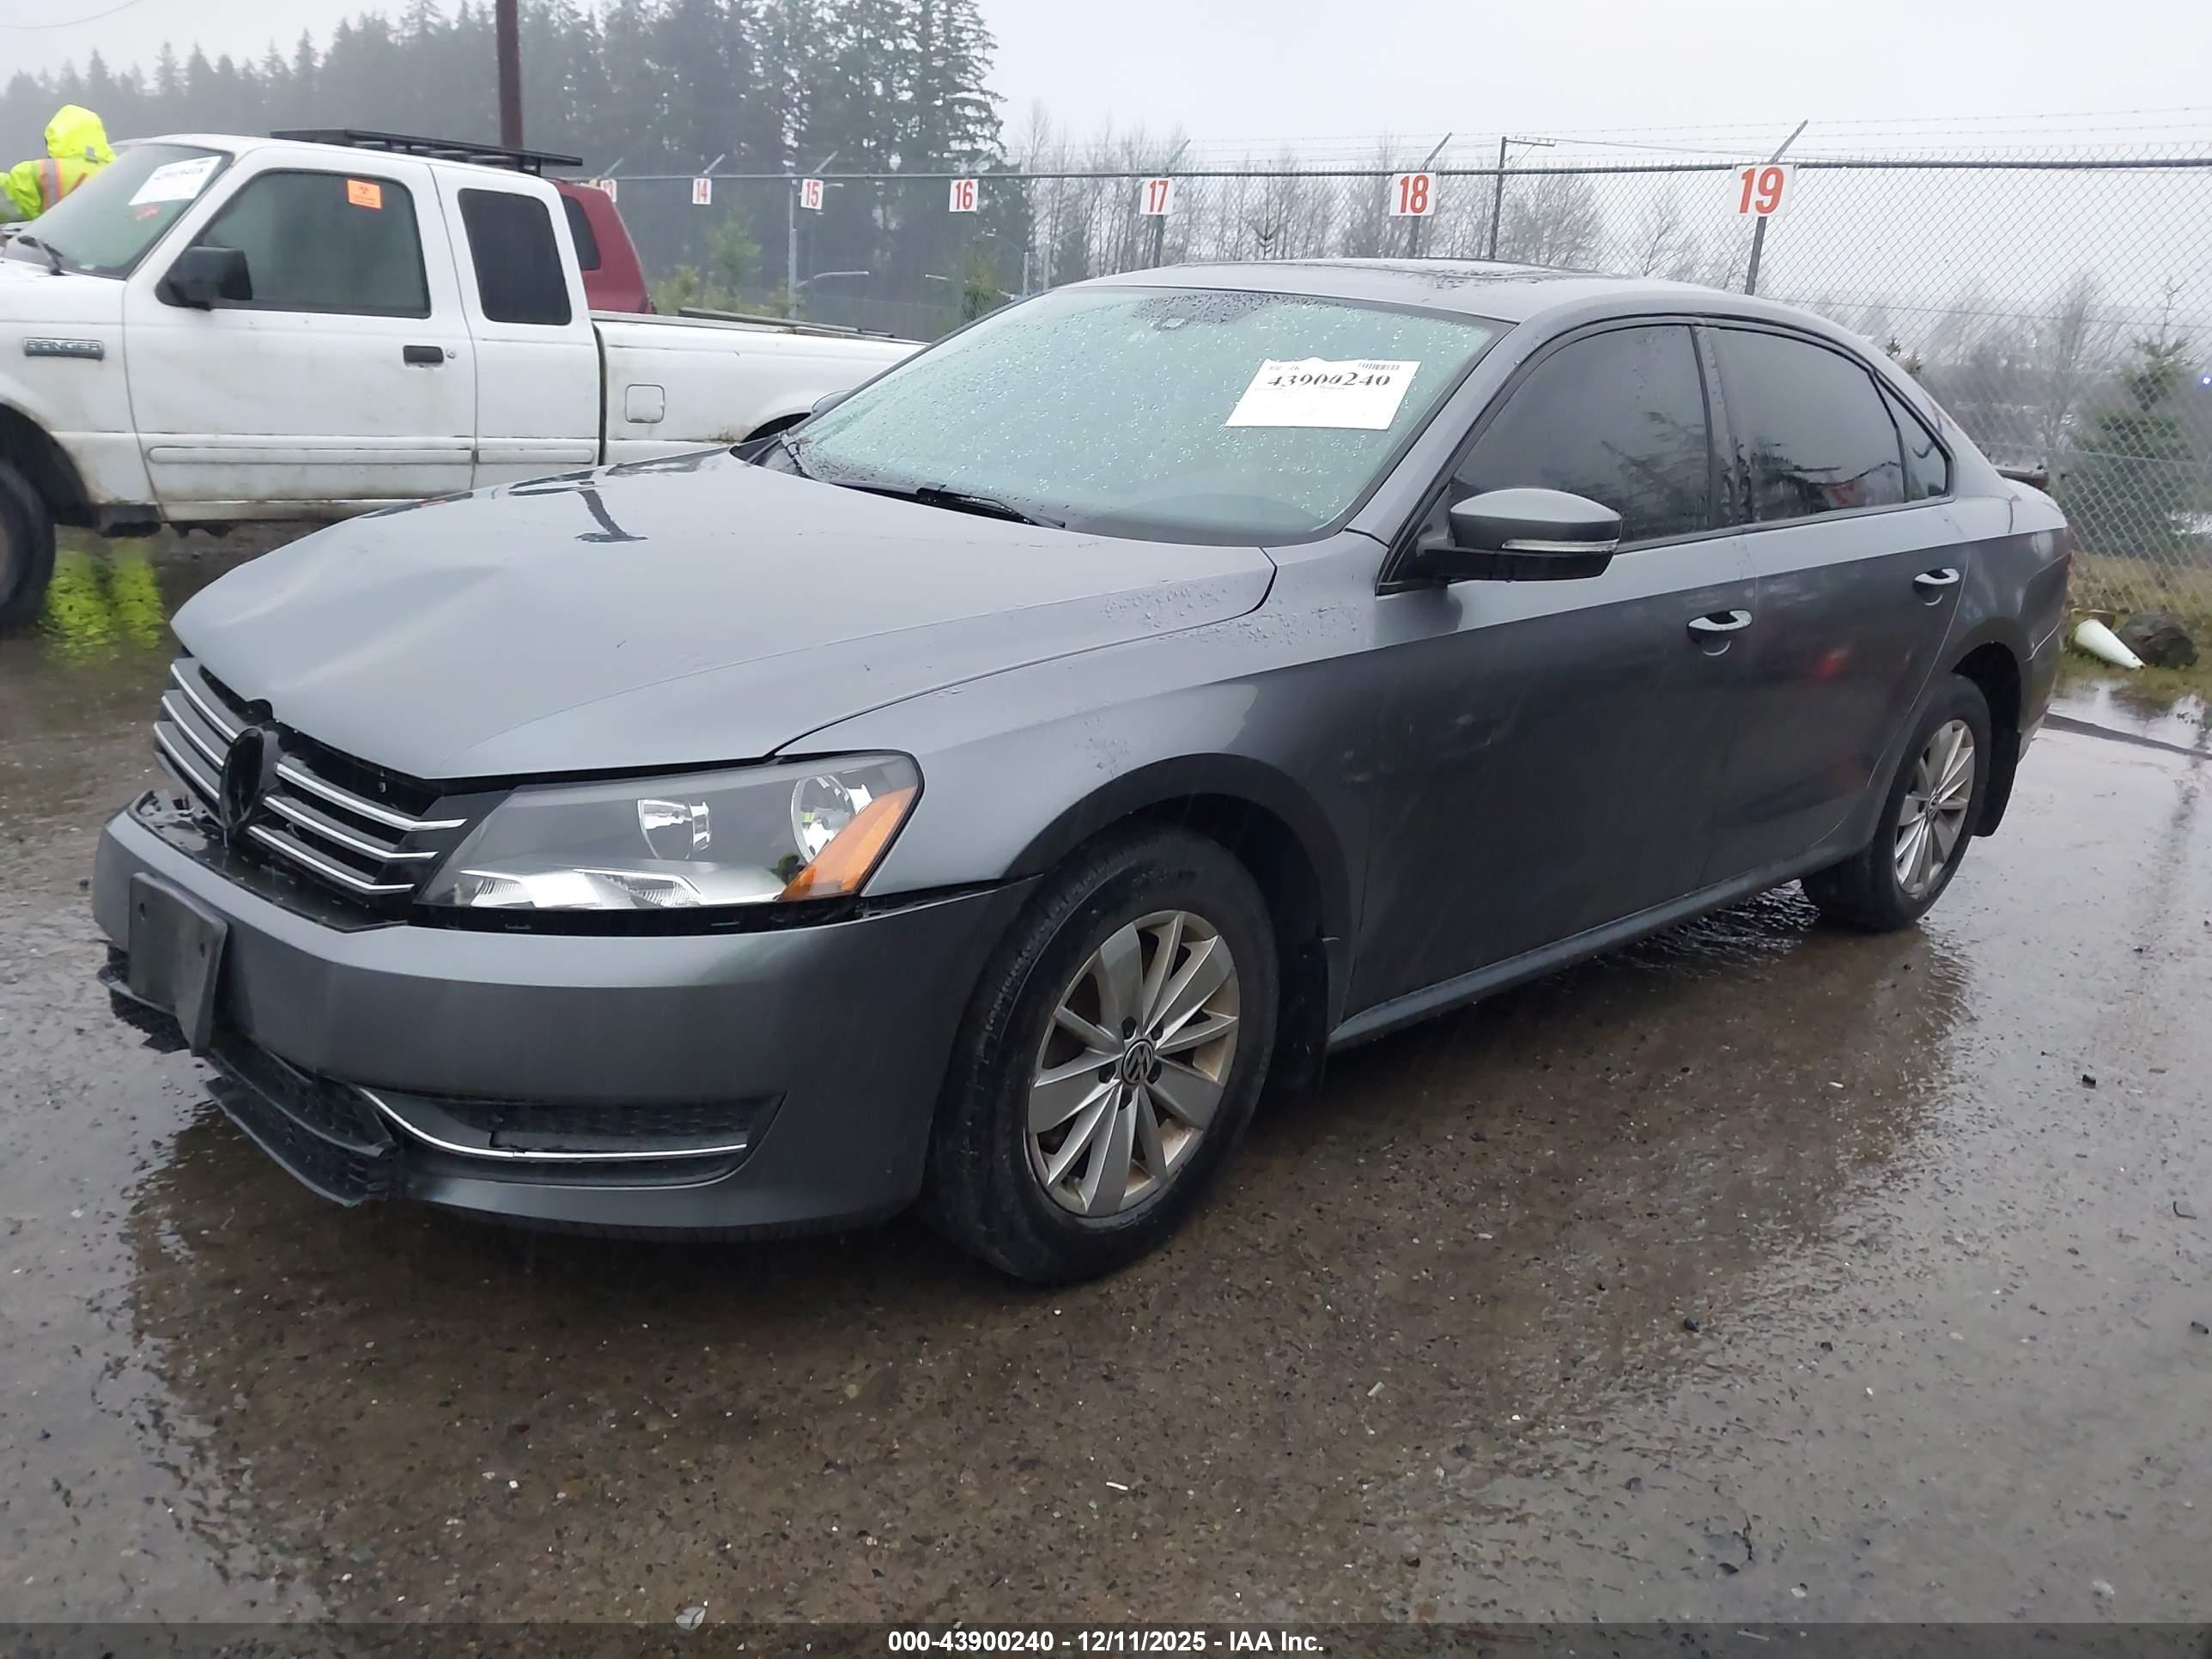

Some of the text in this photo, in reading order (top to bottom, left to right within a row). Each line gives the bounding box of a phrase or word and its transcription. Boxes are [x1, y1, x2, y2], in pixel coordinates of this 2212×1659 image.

[696, 179, 708, 204] 14
[805, 180, 820, 207] 15
[955, 179, 974, 210] 16
[1149, 180, 1169, 213] 17
[1400, 174, 1430, 214] 18
[1739, 167, 1784, 215] 19
[27, 339, 100, 351] RANGER
